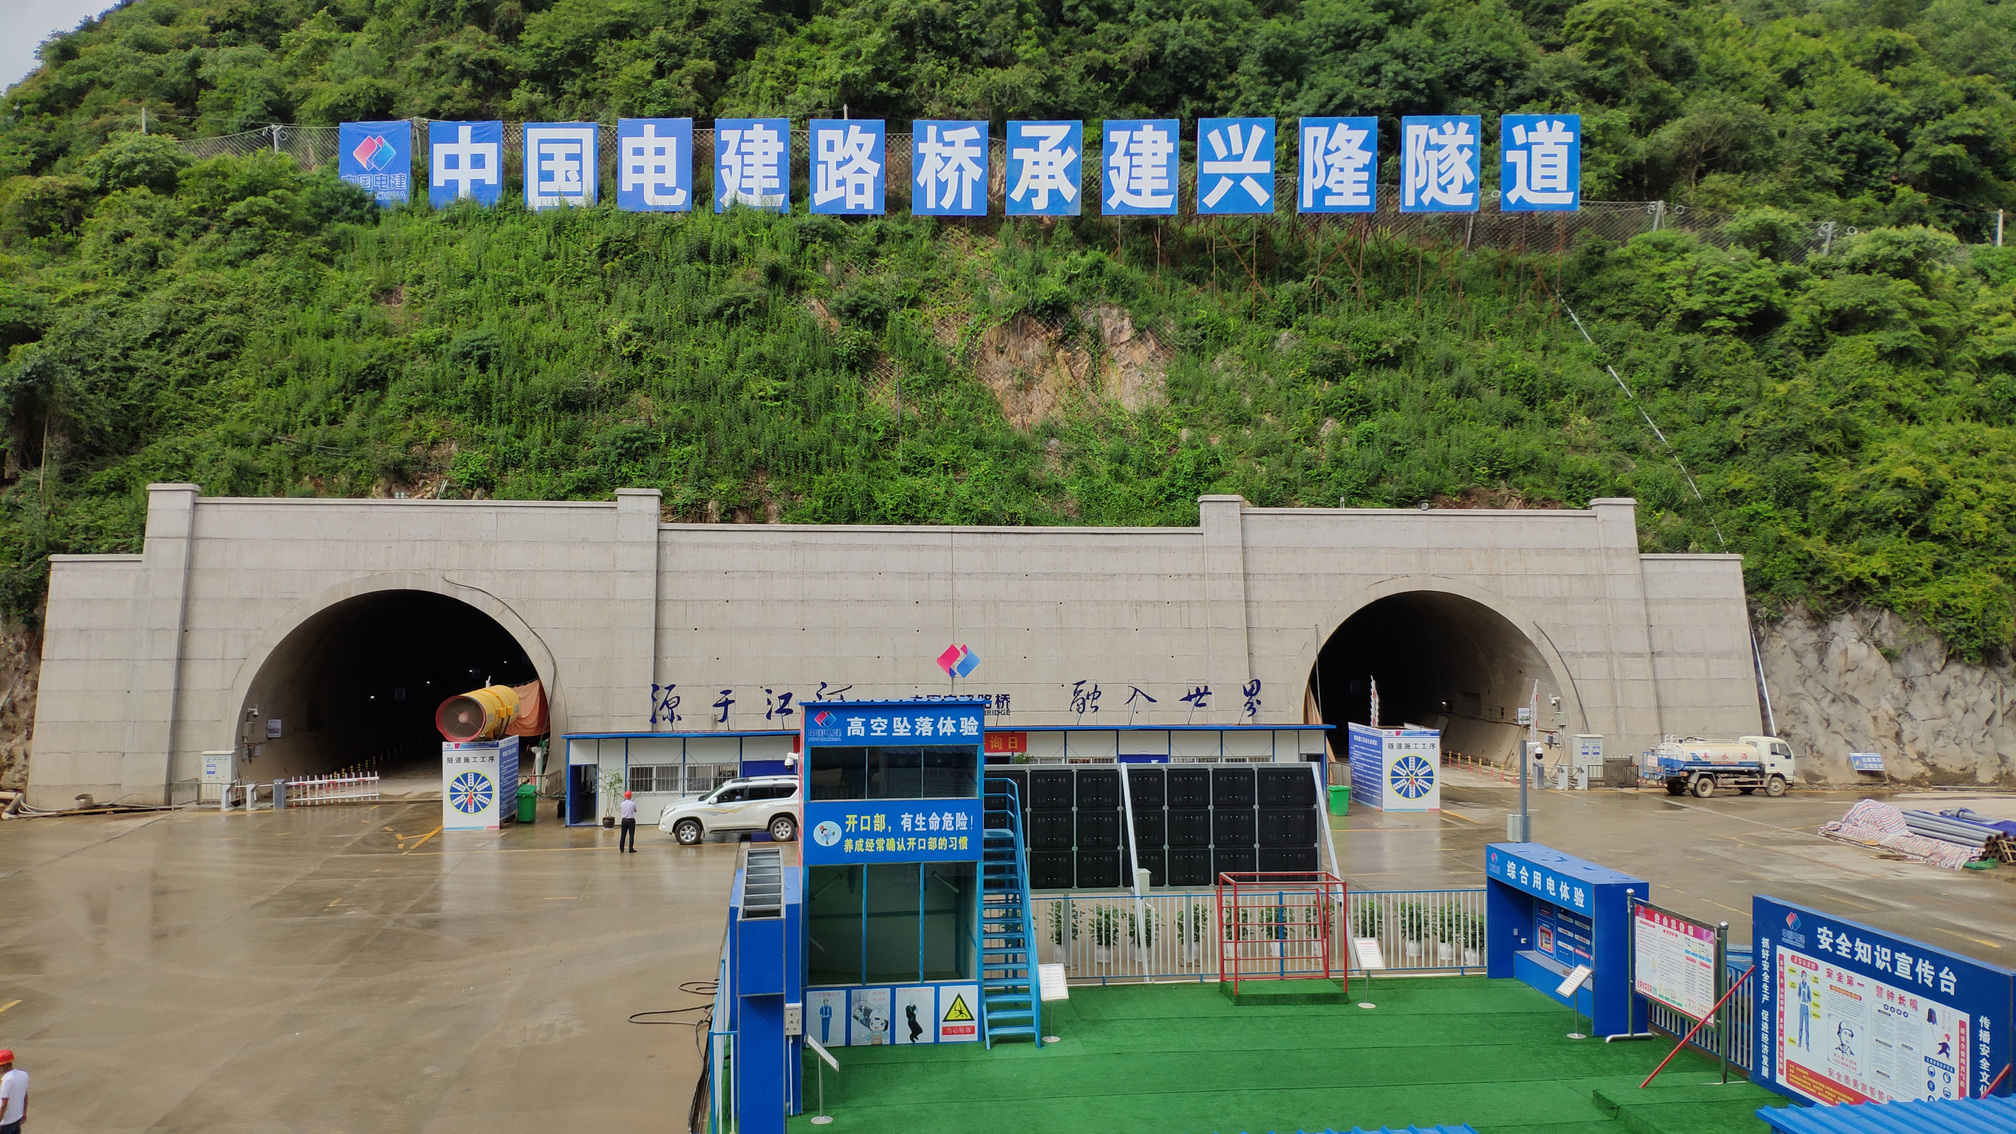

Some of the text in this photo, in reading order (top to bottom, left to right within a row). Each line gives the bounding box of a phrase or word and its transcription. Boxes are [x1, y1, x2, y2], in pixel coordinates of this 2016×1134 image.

[433, 121, 1575, 210] 中国电建路桥承建兴隆隧道
[1069, 678, 1262, 718] 融入世界
[847, 716, 979, 736] 高空坠落体验
[984, 735, 1017, 749] 询日
[1388, 742, 1436, 750] 隧道施工工序
[447, 755, 495, 764] 隧道施工工序
[844, 836, 968, 853] 养成经常确认开口部的习惯
[1506, 860, 1585, 908] 综合用电体验
[1816, 926, 1958, 996] 安全知识宣传台
[1760, 936, 1770, 1079] 抓好安全生产 促进经济发展
[1825, 968, 1865, 988] 安全第一
[1875, 985, 1918, 1011] 警钟长鸣
